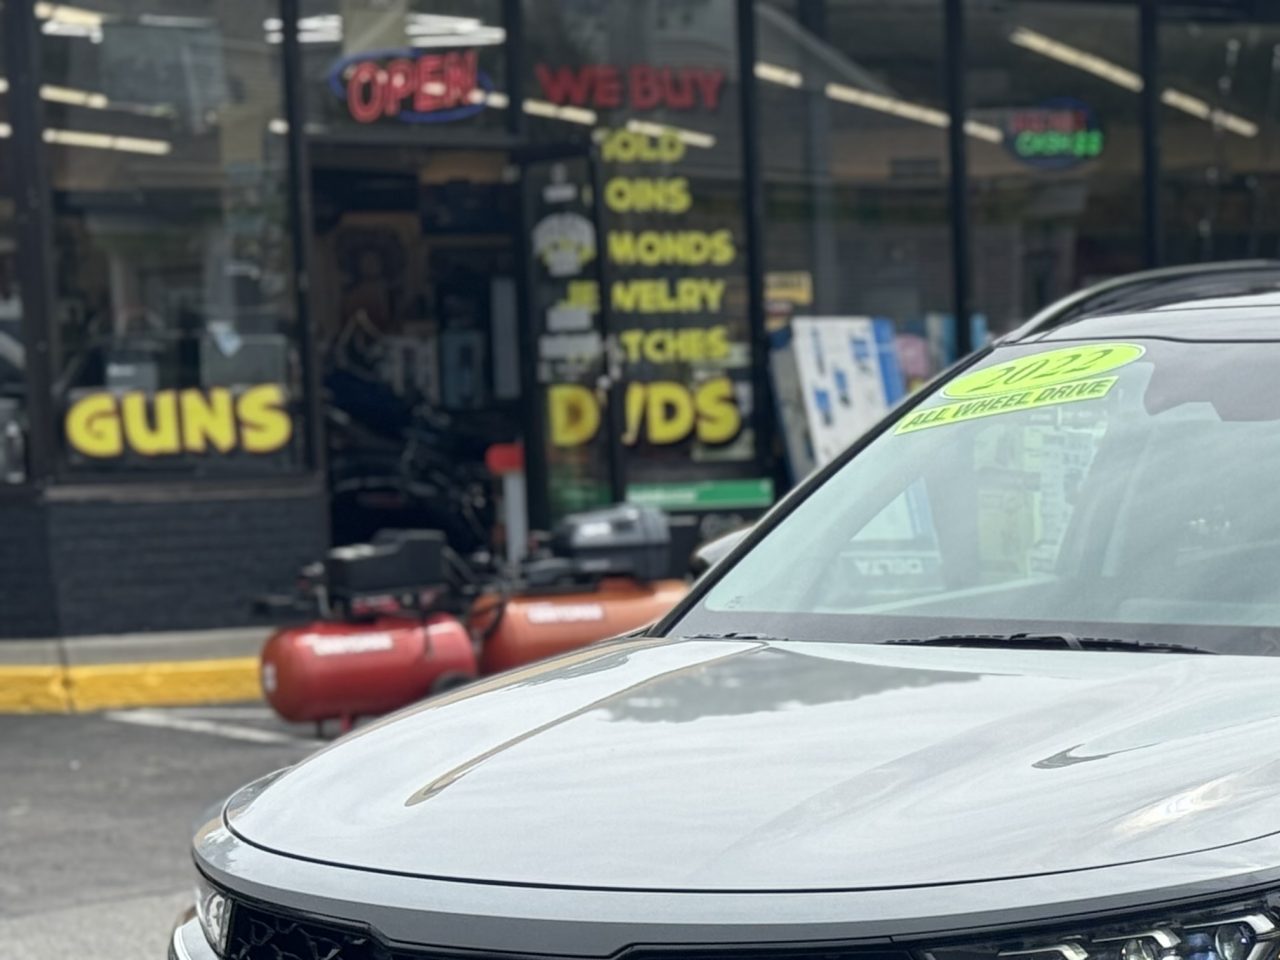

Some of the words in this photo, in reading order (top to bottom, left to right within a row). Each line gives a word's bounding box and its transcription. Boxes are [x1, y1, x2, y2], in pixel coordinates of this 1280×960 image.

[347, 50, 479, 123] OPEN
[535, 63, 623, 107] WE
[630, 64, 725, 110] BUY
[969, 349, 1114, 393] 2022
[65, 384, 292, 457] GUNS
[902, 410, 946, 430] ALL
[953, 391, 1032, 418] WHEEL
[1034, 378, 1111, 403] DRIVE
